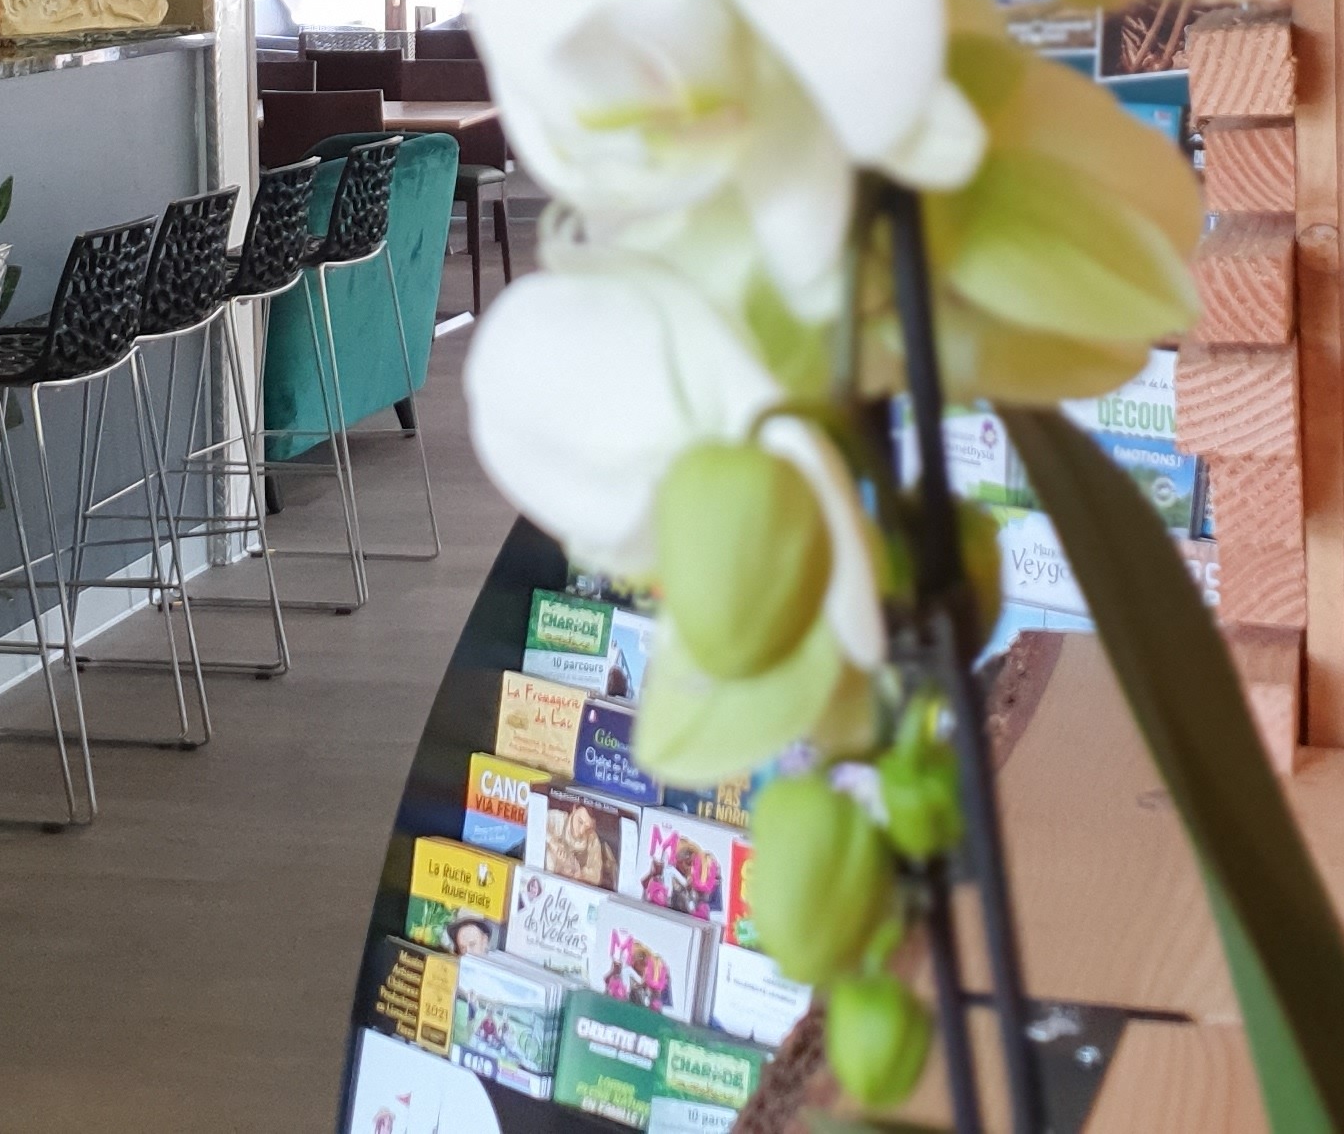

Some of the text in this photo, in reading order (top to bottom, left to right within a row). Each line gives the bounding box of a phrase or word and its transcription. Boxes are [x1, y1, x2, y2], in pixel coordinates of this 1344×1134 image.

[563, 659, 604, 673] parcours
[525, 682, 580, 710] Fromagerie
[480, 770, 530, 805] CANO
[428, 858, 472, 884] La Ruche
